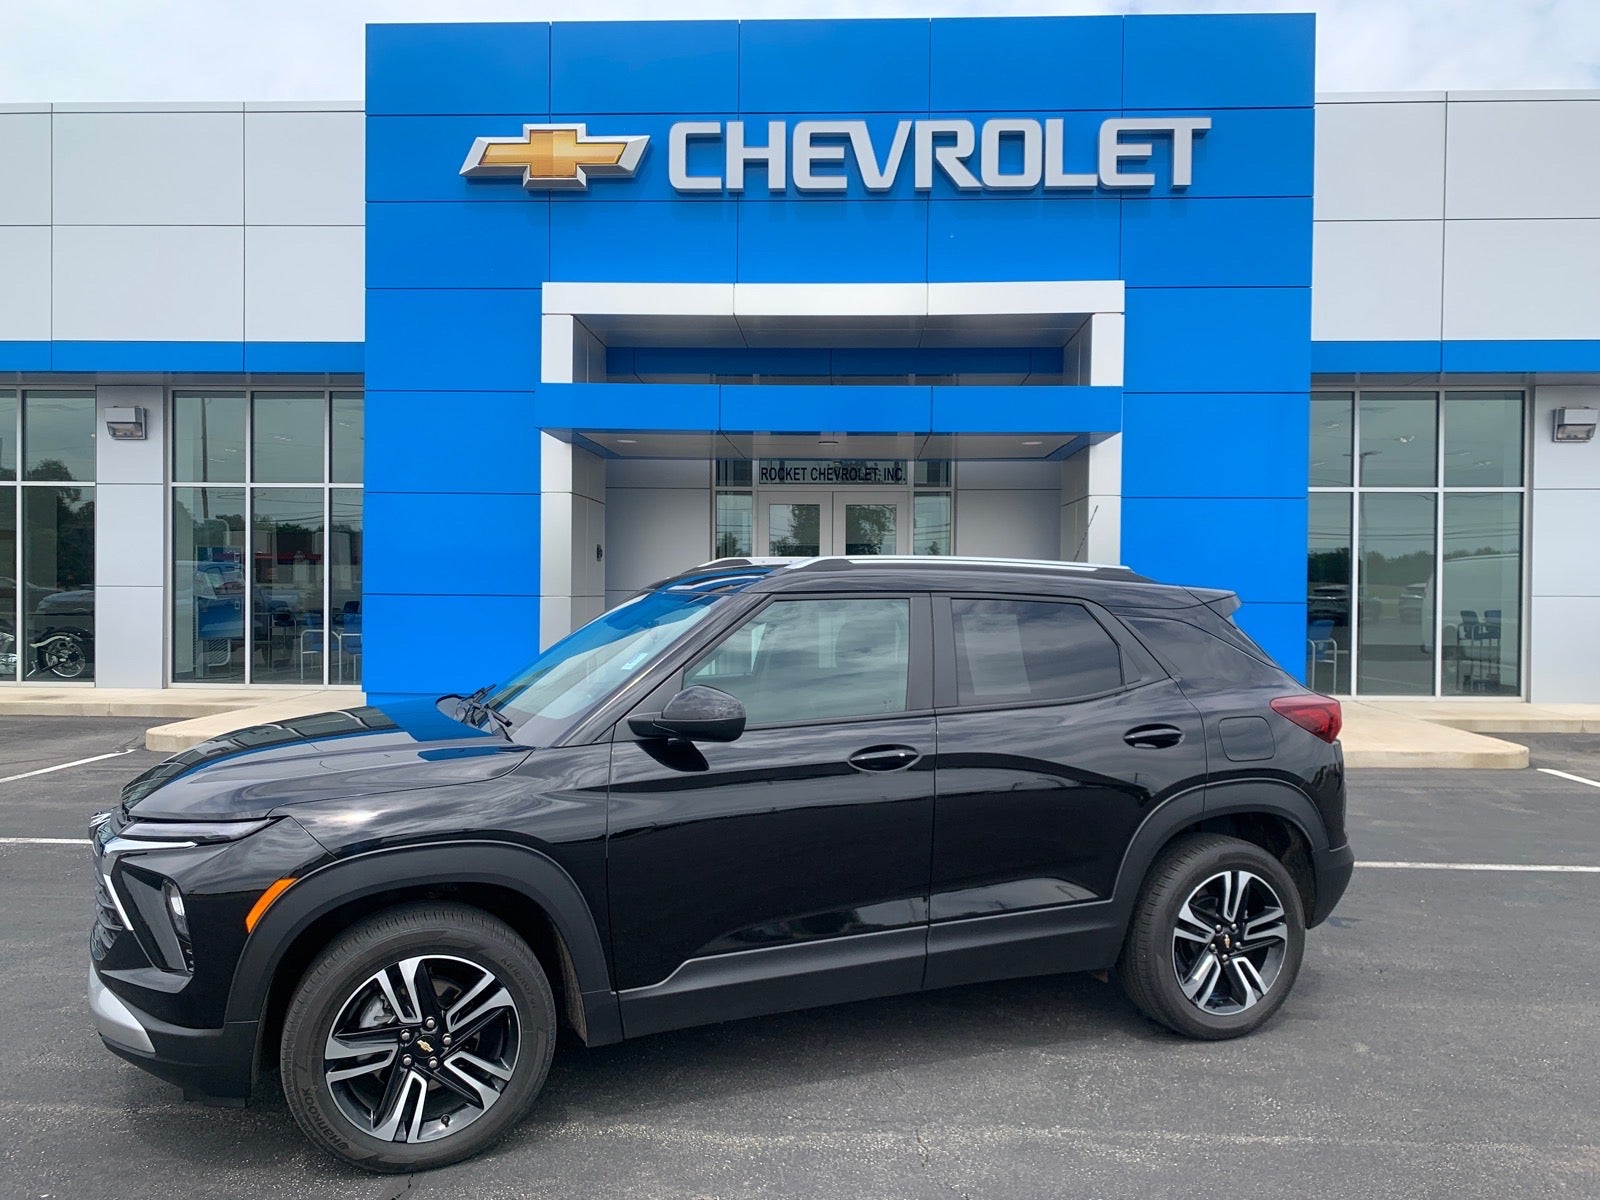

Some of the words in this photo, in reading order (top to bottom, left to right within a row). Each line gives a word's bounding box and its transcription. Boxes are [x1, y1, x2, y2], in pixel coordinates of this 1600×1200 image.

[668, 117, 1212, 192] CHEVROLET
[760, 467, 807, 481] ROCKET
[883, 467, 906, 481] INC.
